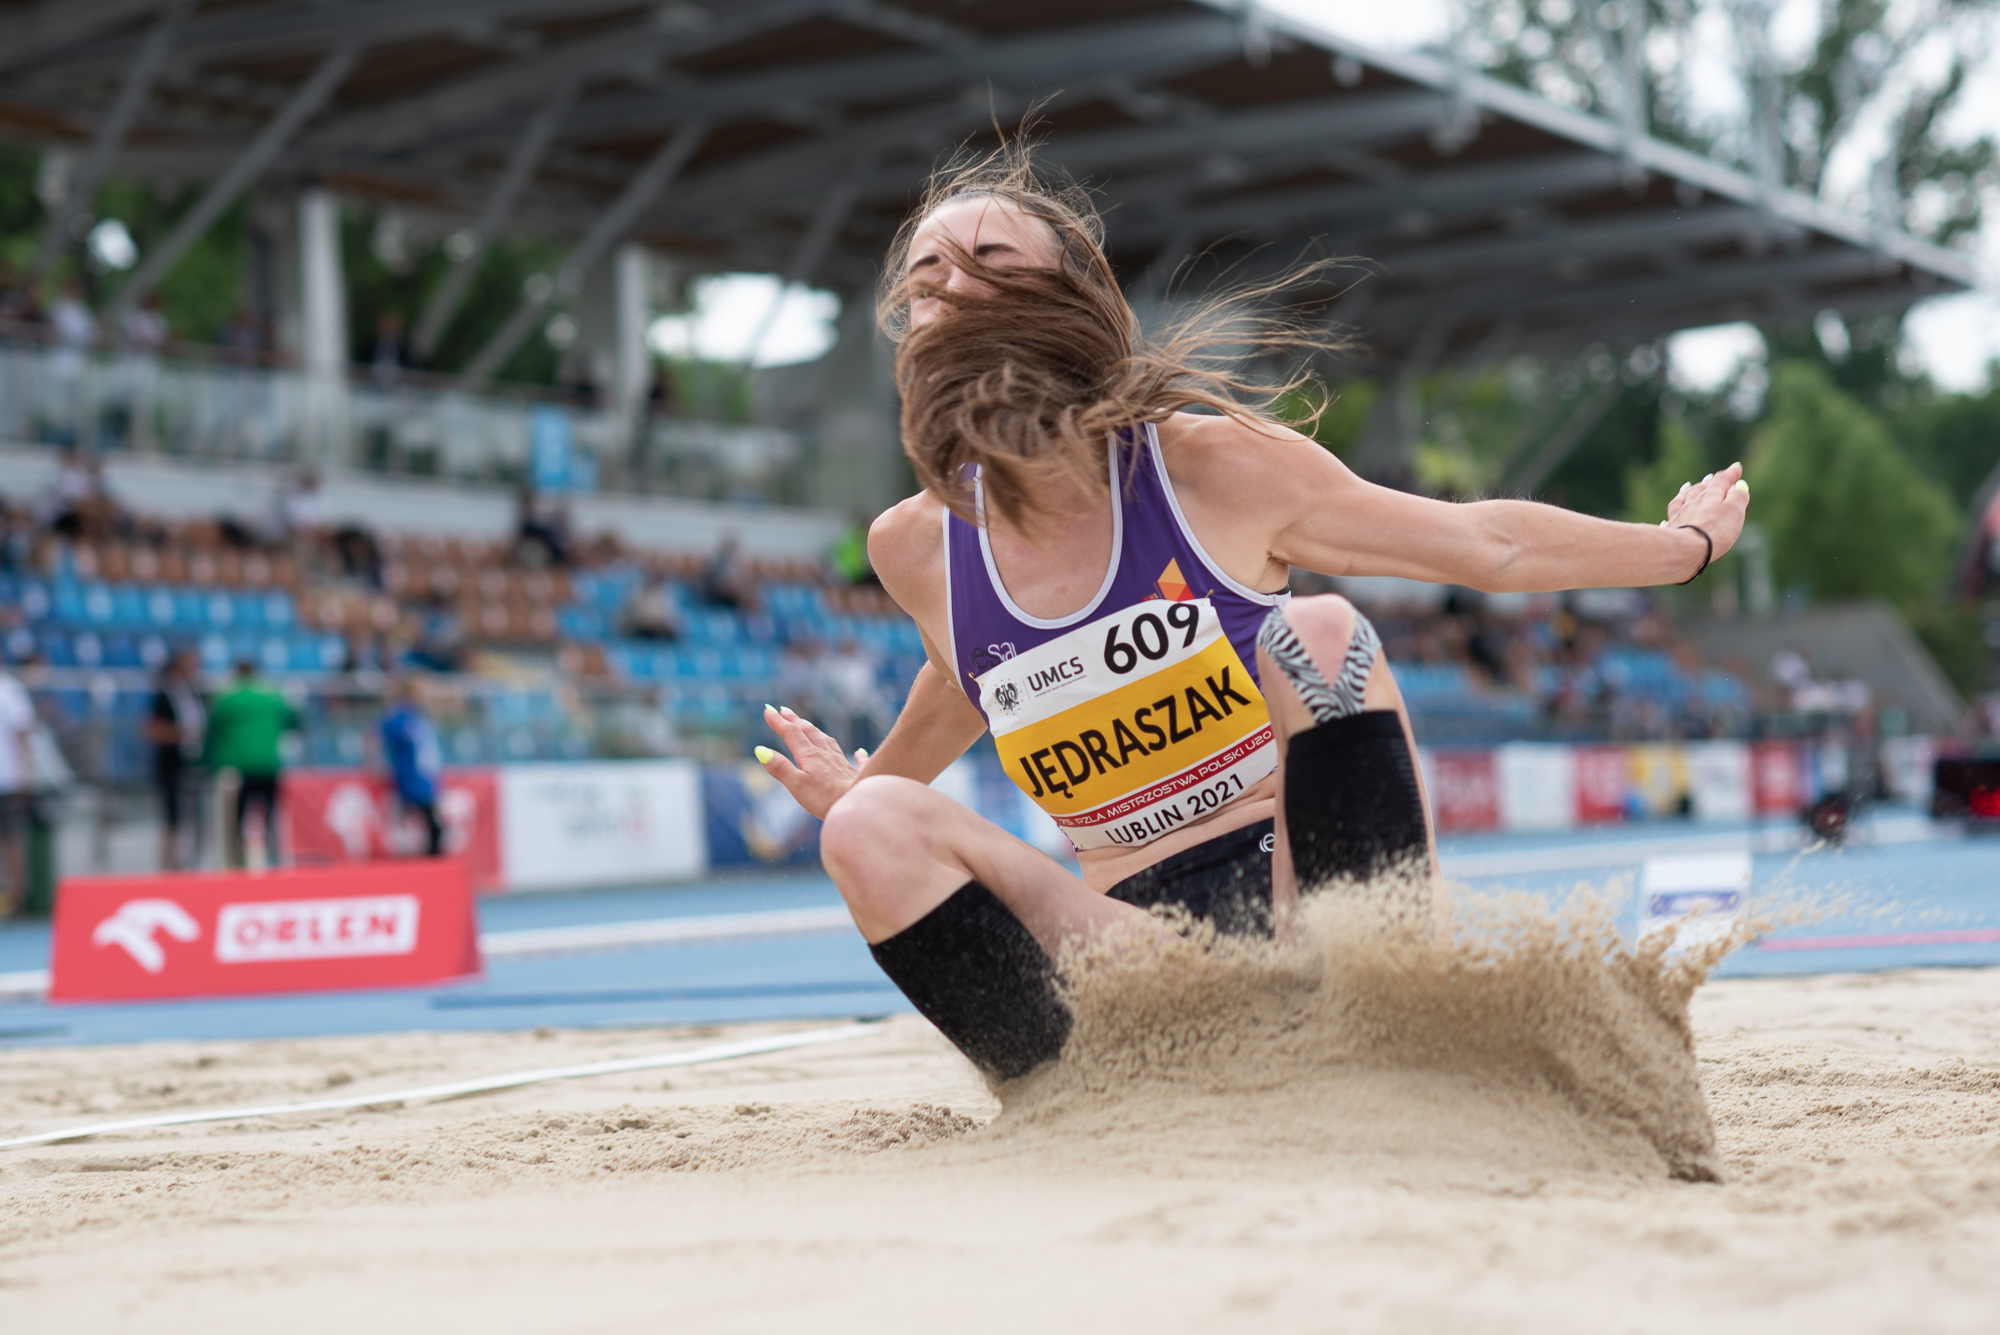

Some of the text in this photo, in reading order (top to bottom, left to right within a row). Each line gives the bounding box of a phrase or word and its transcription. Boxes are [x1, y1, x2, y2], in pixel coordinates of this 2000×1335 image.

[1027, 656, 1084, 692] UMCS
[1103, 602, 1200, 675] 609
[1019, 665, 1252, 799] JĘDRASZAK
[1075, 811, 1107, 826] PZLA
[1106, 774, 1199, 818] MISTRZOSTWA
[1198, 746, 1245, 778] POLSKI
[1244, 730, 1273, 751] U20
[1104, 773, 1245, 845] LUBLIN 2021
